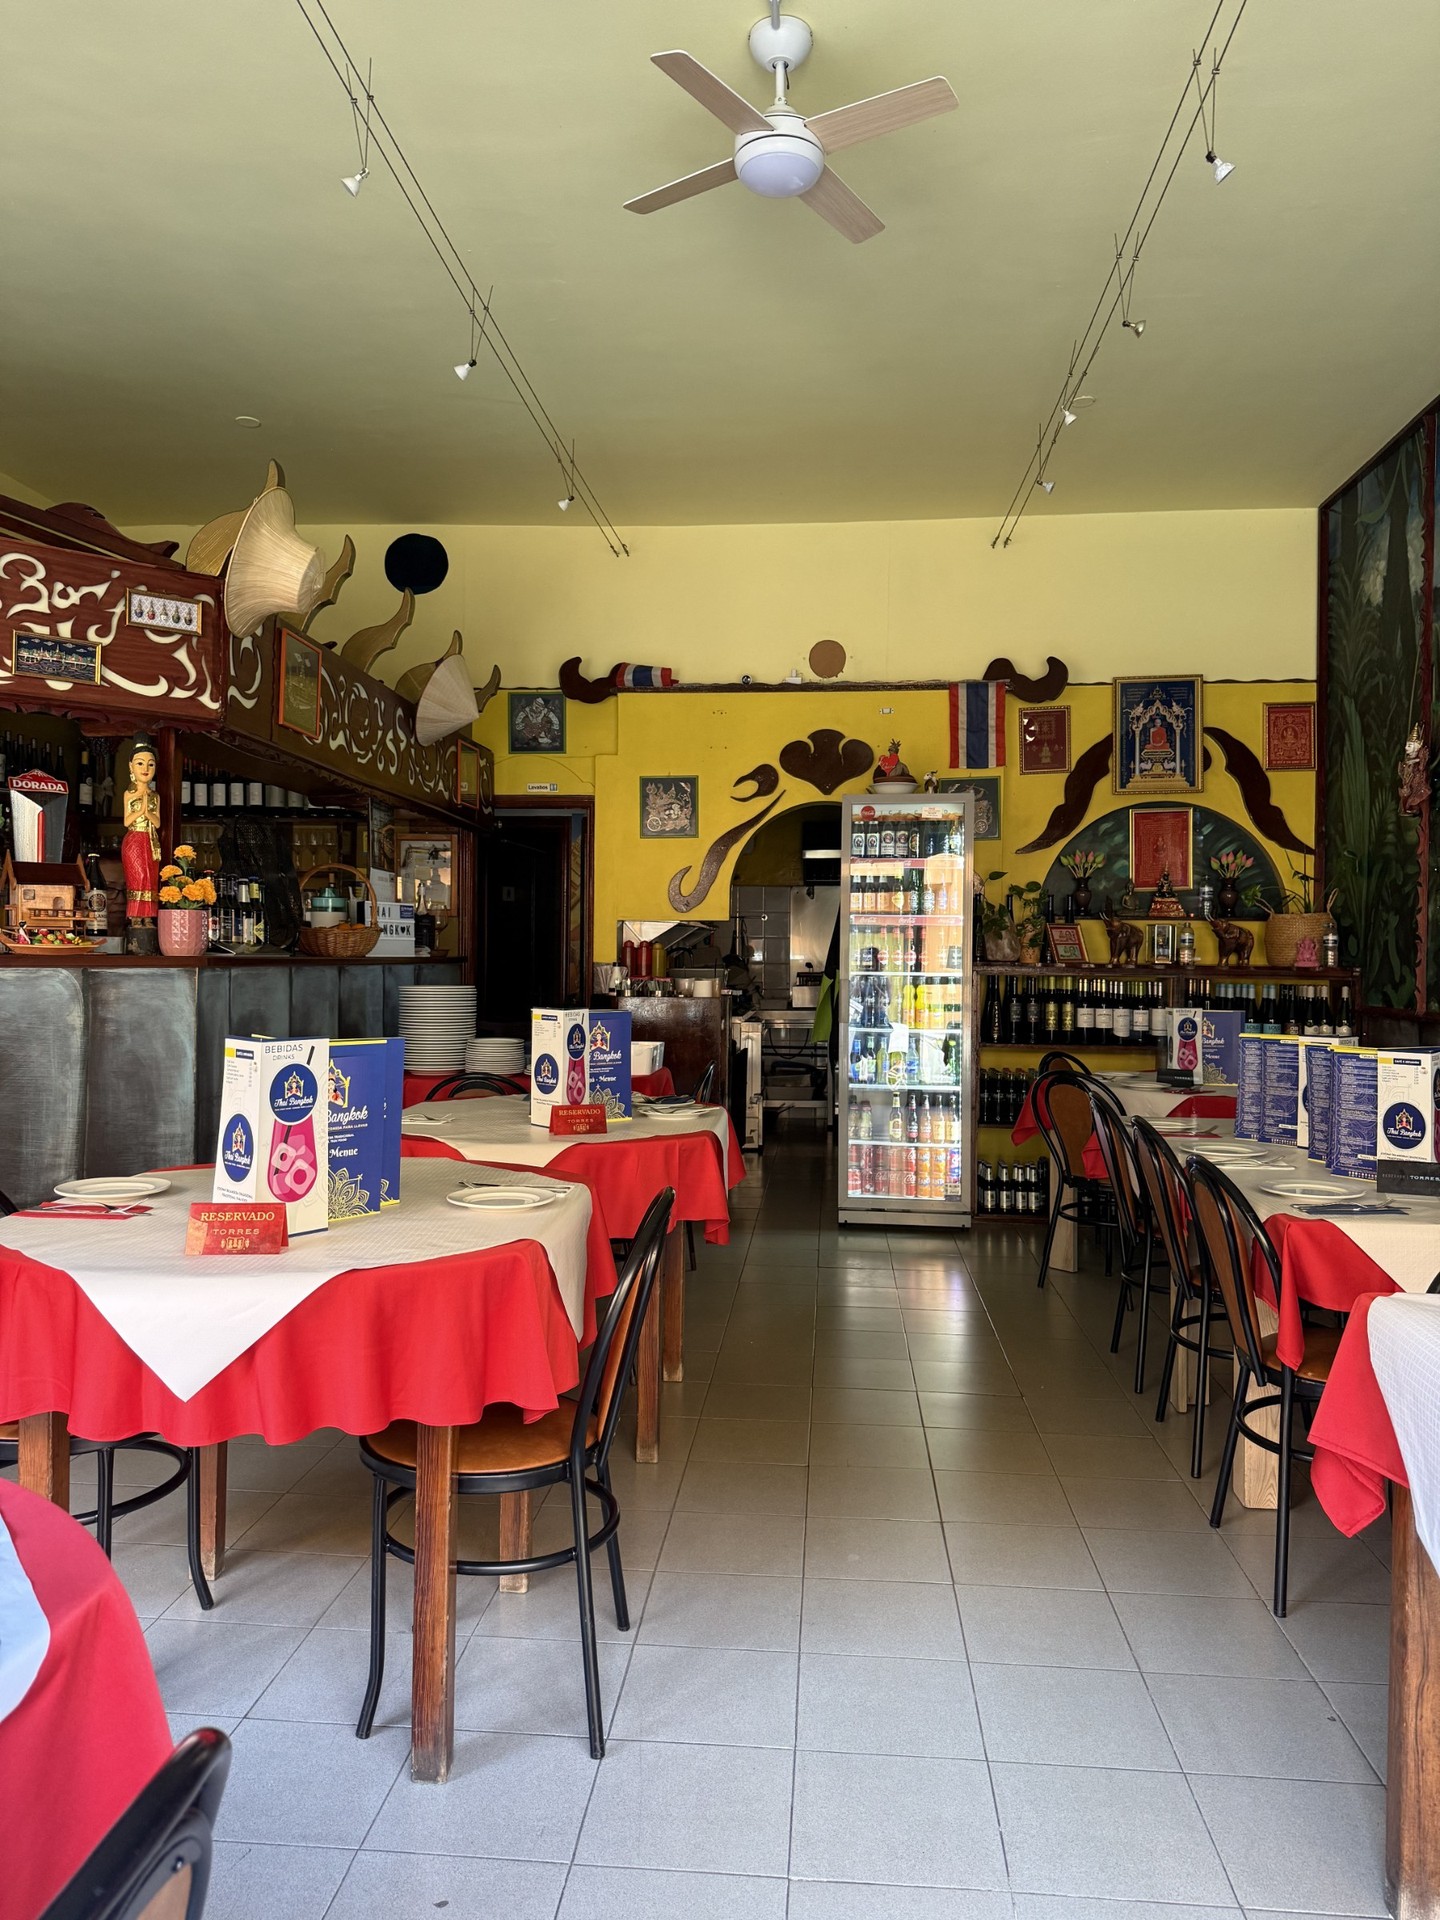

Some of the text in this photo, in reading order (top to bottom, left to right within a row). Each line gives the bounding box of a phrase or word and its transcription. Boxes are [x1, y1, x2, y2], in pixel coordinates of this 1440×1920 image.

[13, 779, 65, 792] DORADA
[265, 1043, 303, 1054] BEBIDAS
[593, 1050, 622, 1062] Bangkok
[274, 1095, 314, 1107] Thai Bangkok
[559, 1108, 601, 1116] RESERVADO
[329, 1146, 358, 1158] Menue
[200, 1211, 275, 1221] RESERVADO
